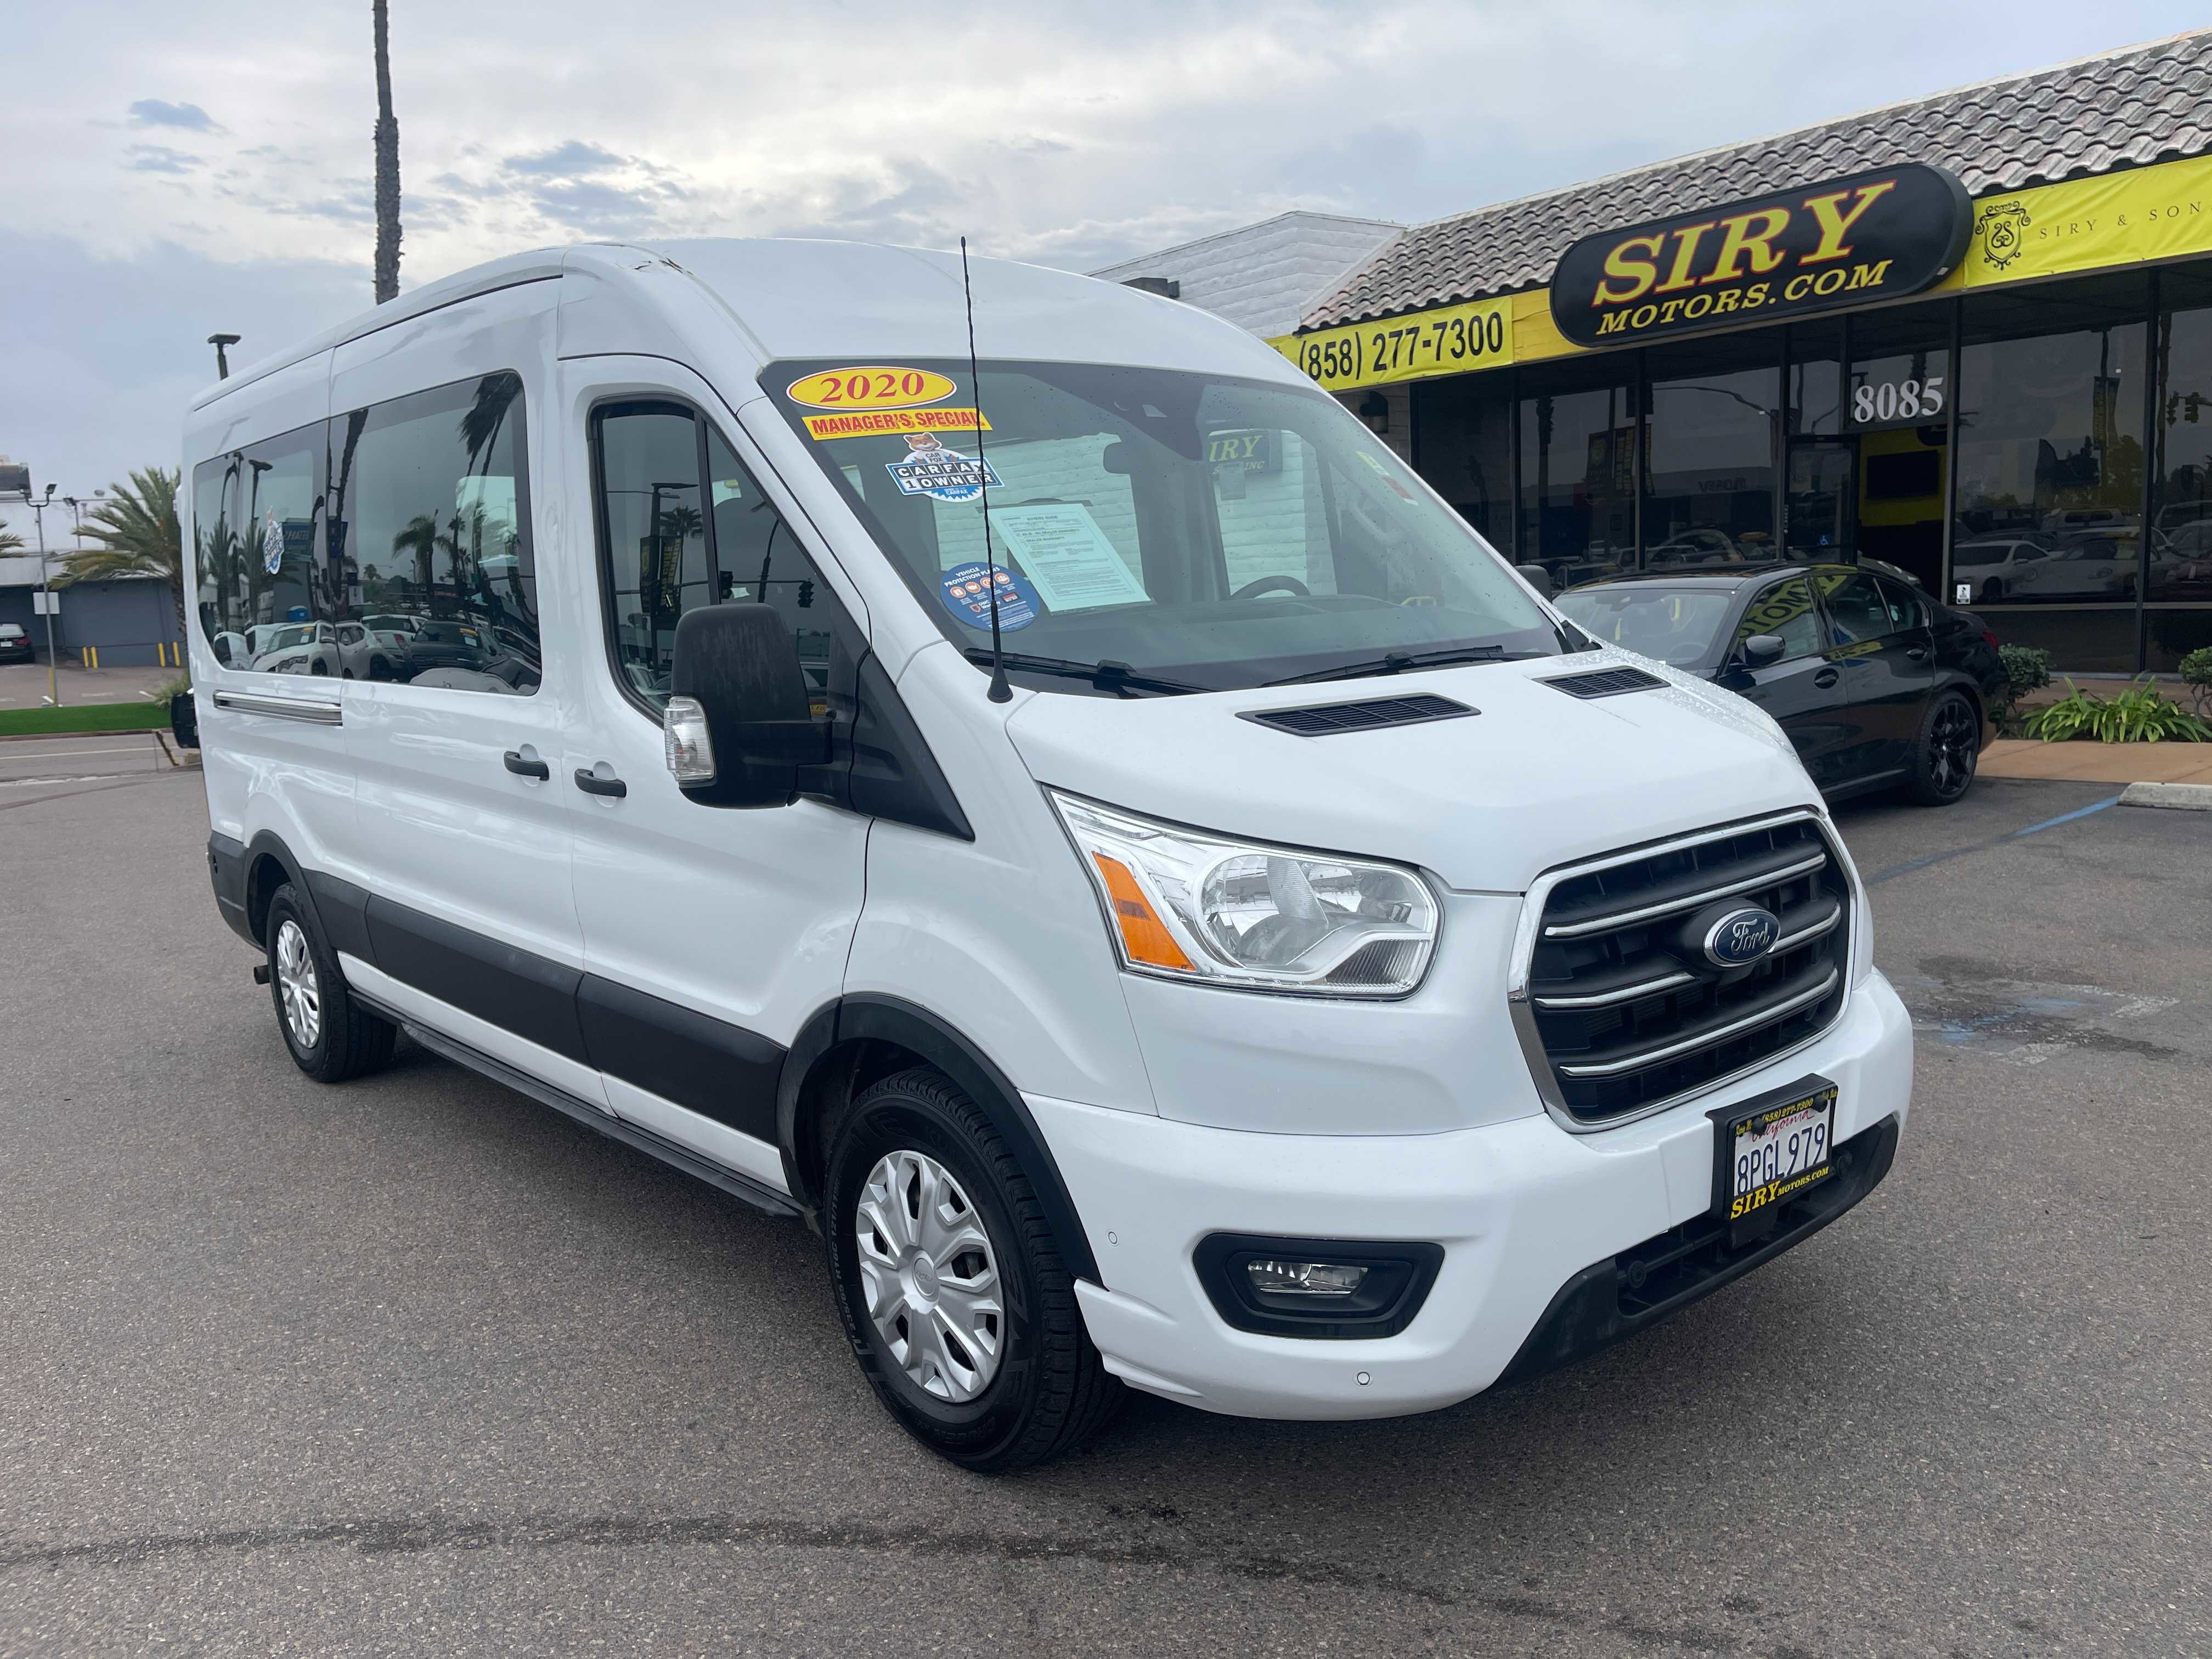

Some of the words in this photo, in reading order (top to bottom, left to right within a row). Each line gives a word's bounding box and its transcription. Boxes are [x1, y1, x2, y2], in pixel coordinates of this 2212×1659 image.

[2039, 219, 2098, 239] SIRY
[2117, 215, 2128, 226] &
[2149, 201, 2212, 221] SON
[1593, 179, 1897, 307] SIRY
[1595, 259, 1894, 335] MOTORS.COM
[1299, 331, 1362, 381] (858)
[1373, 312, 1503, 372] 277-7300
[820, 373, 924, 403] 2020
[1854, 377, 1943, 422] 8085
[811, 413, 914, 435] MANAGER'S
[916, 411, 983, 427] SPECIAL
[1209, 435, 1263, 462] IRY
[898, 462, 990, 477] CARFAX
[905, 480, 917, 489] 1
[920, 475, 994, 487] OWNER
[944, 573, 981, 587] PROTECTION
[956, 567, 980, 577] VEHICLE
[1731, 918, 1770, 955] Ford
[1762, 1109, 1781, 1122] (858)
[1781, 1098, 1814, 1116] 277-7300
[1738, 1123, 1825, 1194] 8PGL979
[1730, 1181, 1781, 1220] SIRY
[1777, 1167, 1829, 1195] MOTORS.COM
